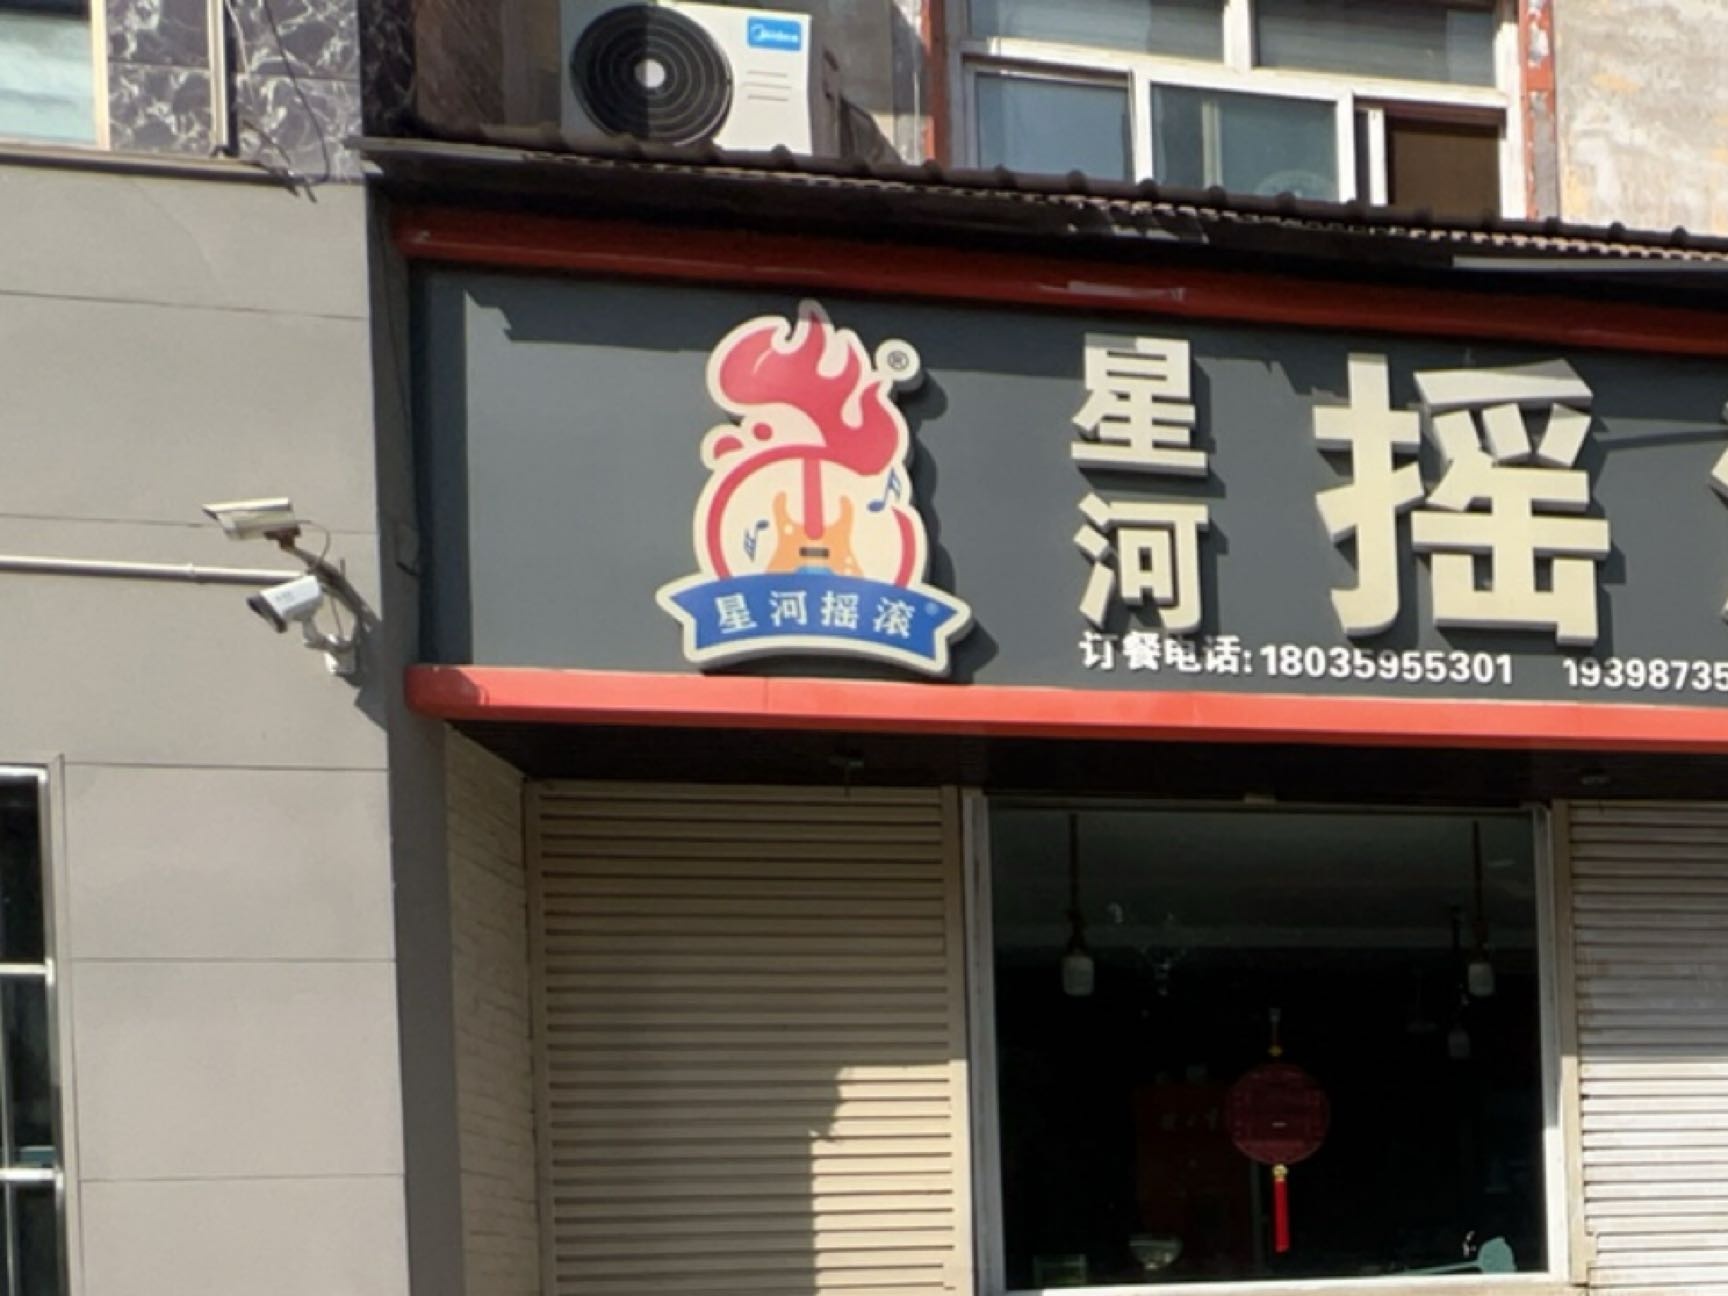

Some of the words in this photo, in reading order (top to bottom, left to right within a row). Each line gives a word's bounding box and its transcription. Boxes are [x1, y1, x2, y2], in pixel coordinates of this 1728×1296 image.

[1071, 332, 1209, 630] 星河
[714, 590, 915, 638] 星河摇滚
